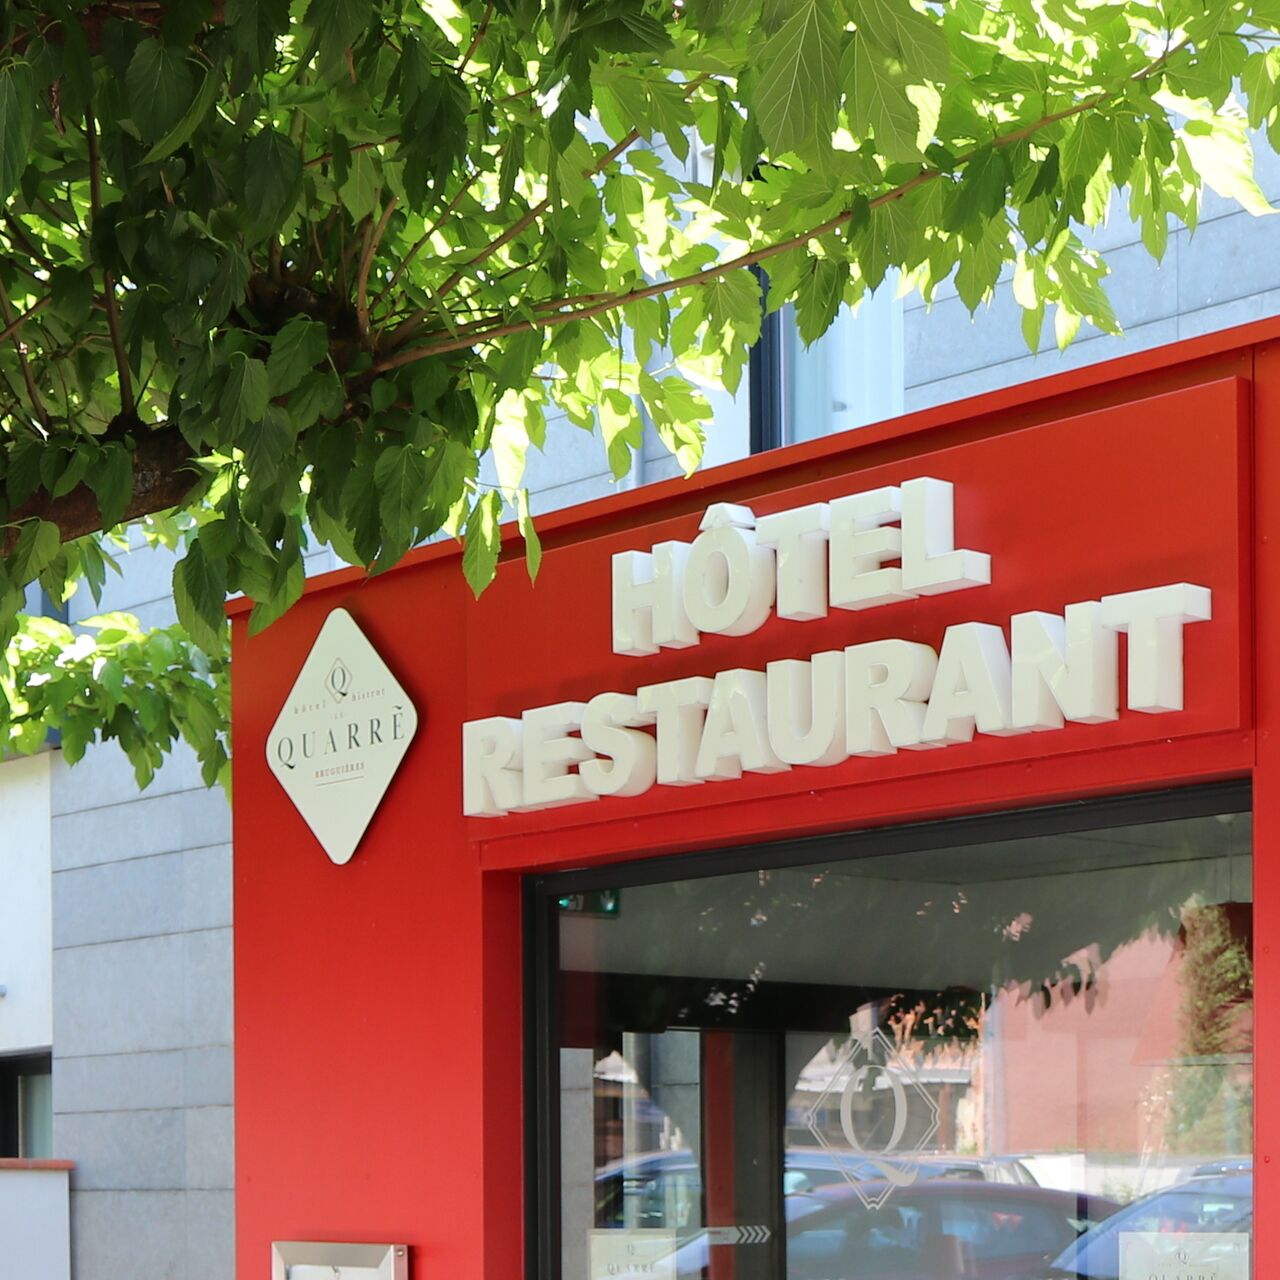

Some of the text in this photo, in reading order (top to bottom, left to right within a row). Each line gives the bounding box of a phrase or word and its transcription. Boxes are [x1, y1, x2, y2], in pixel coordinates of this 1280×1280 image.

[611, 475, 992, 658] HÔTEL
[331, 666, 348, 697] Q
[461, 582, 1213, 819] RESTAURANT
